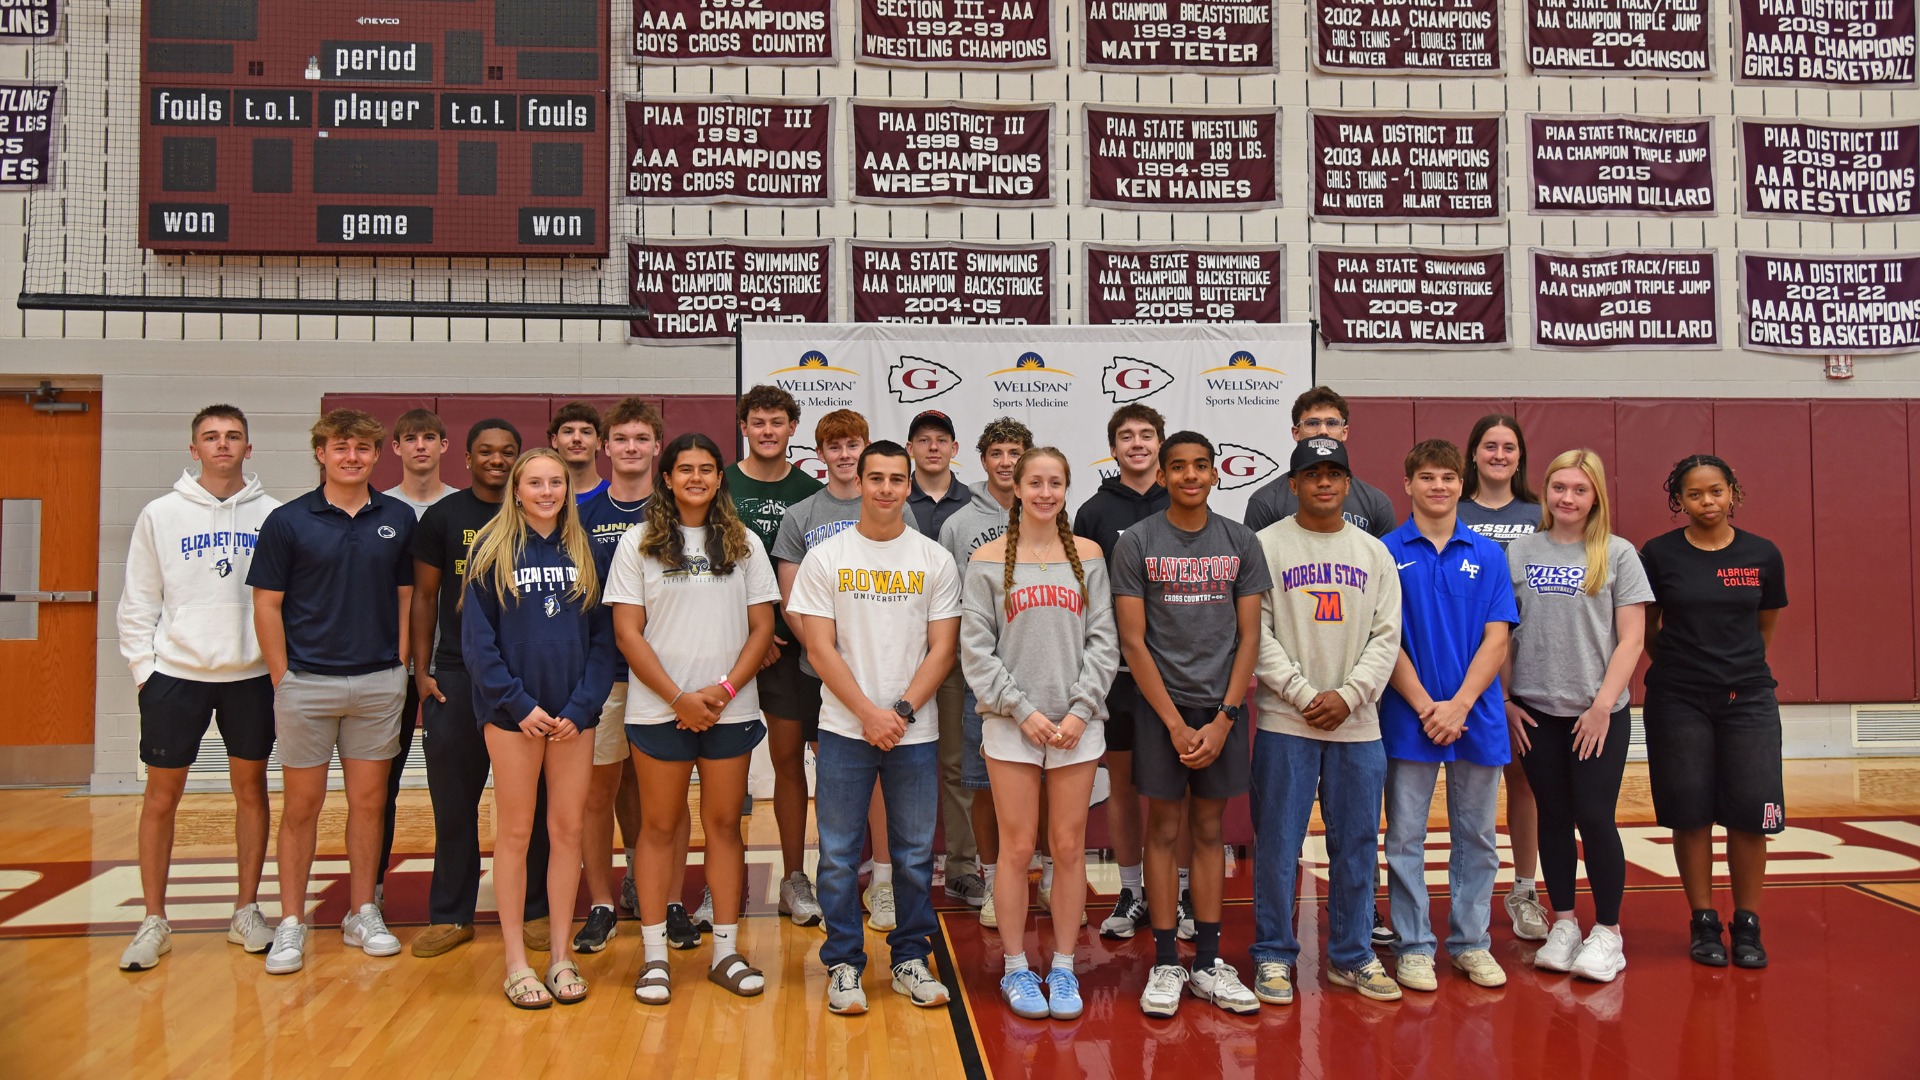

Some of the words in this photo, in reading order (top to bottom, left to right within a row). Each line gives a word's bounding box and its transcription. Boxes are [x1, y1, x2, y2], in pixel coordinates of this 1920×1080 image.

[640, 11, 687, 30] AAA
[700, 10, 825, 30] CHAMPIONS
[1090, 1, 1107, 19] AA
[1112, 2, 1167, 21] CHAMPION
[1180, 3, 1269, 24] BREASTSTROKE
[1324, 7, 1362, 26] 2002
[1371, 9, 1401, 27] AAA
[1409, 9, 1491, 29] CHAMPIONS
[1537, 9, 1560, 28] AAA
[1566, 11, 1621, 29] CHAMPION
[1627, 8, 1666, 31] TRIPLE
[1672, 13, 1701, 31] JUMP
[637, 32, 678, 52] BOYS
[689, 33, 740, 53] CROSS
[752, 34, 826, 53] COUNTRY
[867, 38, 952, 57] WRESTLING
[960, 38, 1047, 58] CHAMPIONS
[1592, 32, 1646, 47] 2004
[1745, 32, 1807, 55] AAAAA
[1815, 35, 1914, 59] CHAMPIONS
[336, 43, 416, 76] period
[1102, 40, 1160, 59] MATT
[1170, 41, 1258, 62] TEETER
[1533, 47, 1615, 67] DARNELL
[1624, 49, 1706, 69] JOHNSON
[1744, 54, 1793, 77] GIRLS
[1799, 58, 1913, 81] BASKETBALL
[160, 92, 221, 121] fouls
[335, 93, 419, 127] player
[528, 99, 587, 126] fouls
[644, 106, 684, 125] PIAA
[698, 106, 772, 127] DISTRICT
[784, 109, 812, 128] III
[879, 112, 916, 132] PIAA
[925, 112, 995, 135] DISTRICT
[1004, 116, 1025, 135] III
[1107, 117, 1136, 137] PIAA
[1144, 120, 1184, 139] STATE
[1191, 120, 1257, 139] WRESTLING
[1339, 124, 1374, 143] PIAA
[1382, 124, 1446, 144] DISTRICT
[1456, 126, 1473, 144] III
[698, 127, 757, 143] 1993
[906, 134, 960, 149] 1998
[970, 136, 998, 151] 99
[632, 148, 679, 167] AAA
[692, 148, 821, 169] CHAMPIONS
[1099, 138, 1126, 158] AAA
[1133, 141, 1194, 160] CHAMPION
[1210, 141, 1232, 160] 189
[1239, 141, 1266, 159] LBS.
[1324, 147, 1362, 166] 2003
[1371, 147, 1402, 166] AAA
[1409, 148, 1489, 167] CHAMPIONS
[1537, 145, 1563, 160] AAA
[1567, 145, 1628, 160] CHAMPION
[1633, 146, 1672, 163] TRIPLE
[1675, 148, 1706, 163] JUMP
[863, 151, 910, 171] AAA
[918, 151, 1041, 173] CHAMPIONS
[1599, 165, 1651, 180] 2015
[630, 172, 672, 191] BOYS
[683, 171, 735, 191] CROSS
[747, 173, 822, 193] COUNTRY
[872, 172, 1033, 195] WRESTLING
[1326, 170, 1351, 189] GIRLS
[1357, 171, 1387, 189] TENNIS
[1422, 171, 1458, 190] DOUBLES
[1464, 172, 1488, 190] TEAM
[1755, 164, 1794, 187] AAA
[1803, 167, 1915, 191] CHAMPIONS
[1116, 178, 1161, 198] KEN
[1169, 180, 1251, 199] HAINES
[1538, 185, 1632, 204] RAVAUGHN
[1637, 186, 1711, 206] DILLARD
[1322, 193, 1340, 207] ALI
[1346, 194, 1384, 208] MOYER
[1403, 194, 1441, 208] HILARY
[1448, 195, 1492, 209] TEETER
[1759, 190, 1911, 214] WRESTLING
[164, 212, 214, 233] won
[343, 214, 407, 240] game
[533, 216, 581, 236] won
[639, 251, 676, 271] PIAA
[686, 250, 735, 271] STATE
[744, 252, 819, 272] SWIMMING
[865, 251, 901, 270] PIAA
[910, 251, 958, 271] STATE
[967, 253, 1038, 273] SWIMMING
[1108, 255, 1140, 269] PIAA
[1150, 254, 1189, 269] STATE
[1198, 255, 1260, 269] SWIMMING
[637, 273, 663, 293] AAA
[672, 273, 732, 293] CHAMPION
[740, 274, 821, 294] BACKSTROKE
[1103, 287, 1126, 301] AAA
[1135, 286, 1192, 301] CHAMPION
[1200, 287, 1266, 301] BUTTERFLY
[1600, 300, 1651, 316] 2016
[1752, 299, 1816, 323] AAAAA
[653, 314, 728, 334] TRICIA
[1343, 319, 1403, 339] TRICIA
[1410, 320, 1484, 340] WEANER
[1541, 320, 1634, 341] RAVAUGHN
[1639, 320, 1712, 338] DILLARD
[1750, 322, 1803, 345] GIRLS
[902, 368, 940, 391] G
[1116, 368, 1152, 391] G
[808, 396, 853, 407] Medicine
[993, 397, 1023, 409] Sports
[1025, 397, 1069, 408] Medicine
[1205, 396, 1235, 408] Sports
[1237, 396, 1280, 406] Medicine
[1221, 455, 1258, 477] G
[1145, 555, 1241, 583] HAVERFORD
[1281, 563, 1332, 593] MORGAN
[1334, 563, 1368, 594] STATE
[1525, 565, 1584, 580] WILSO
[1716, 567, 1760, 579] ALBRIGHT
[838, 568, 925, 594] ROWAN
[1164, 581, 1227, 593] COLLEGE
[1723, 577, 1760, 588] COLLEGE
[853, 592, 908, 602] UNIVERSITY
[1164, 594, 1183, 603] CROSS
[1183, 594, 1211, 602] COUNTRY
